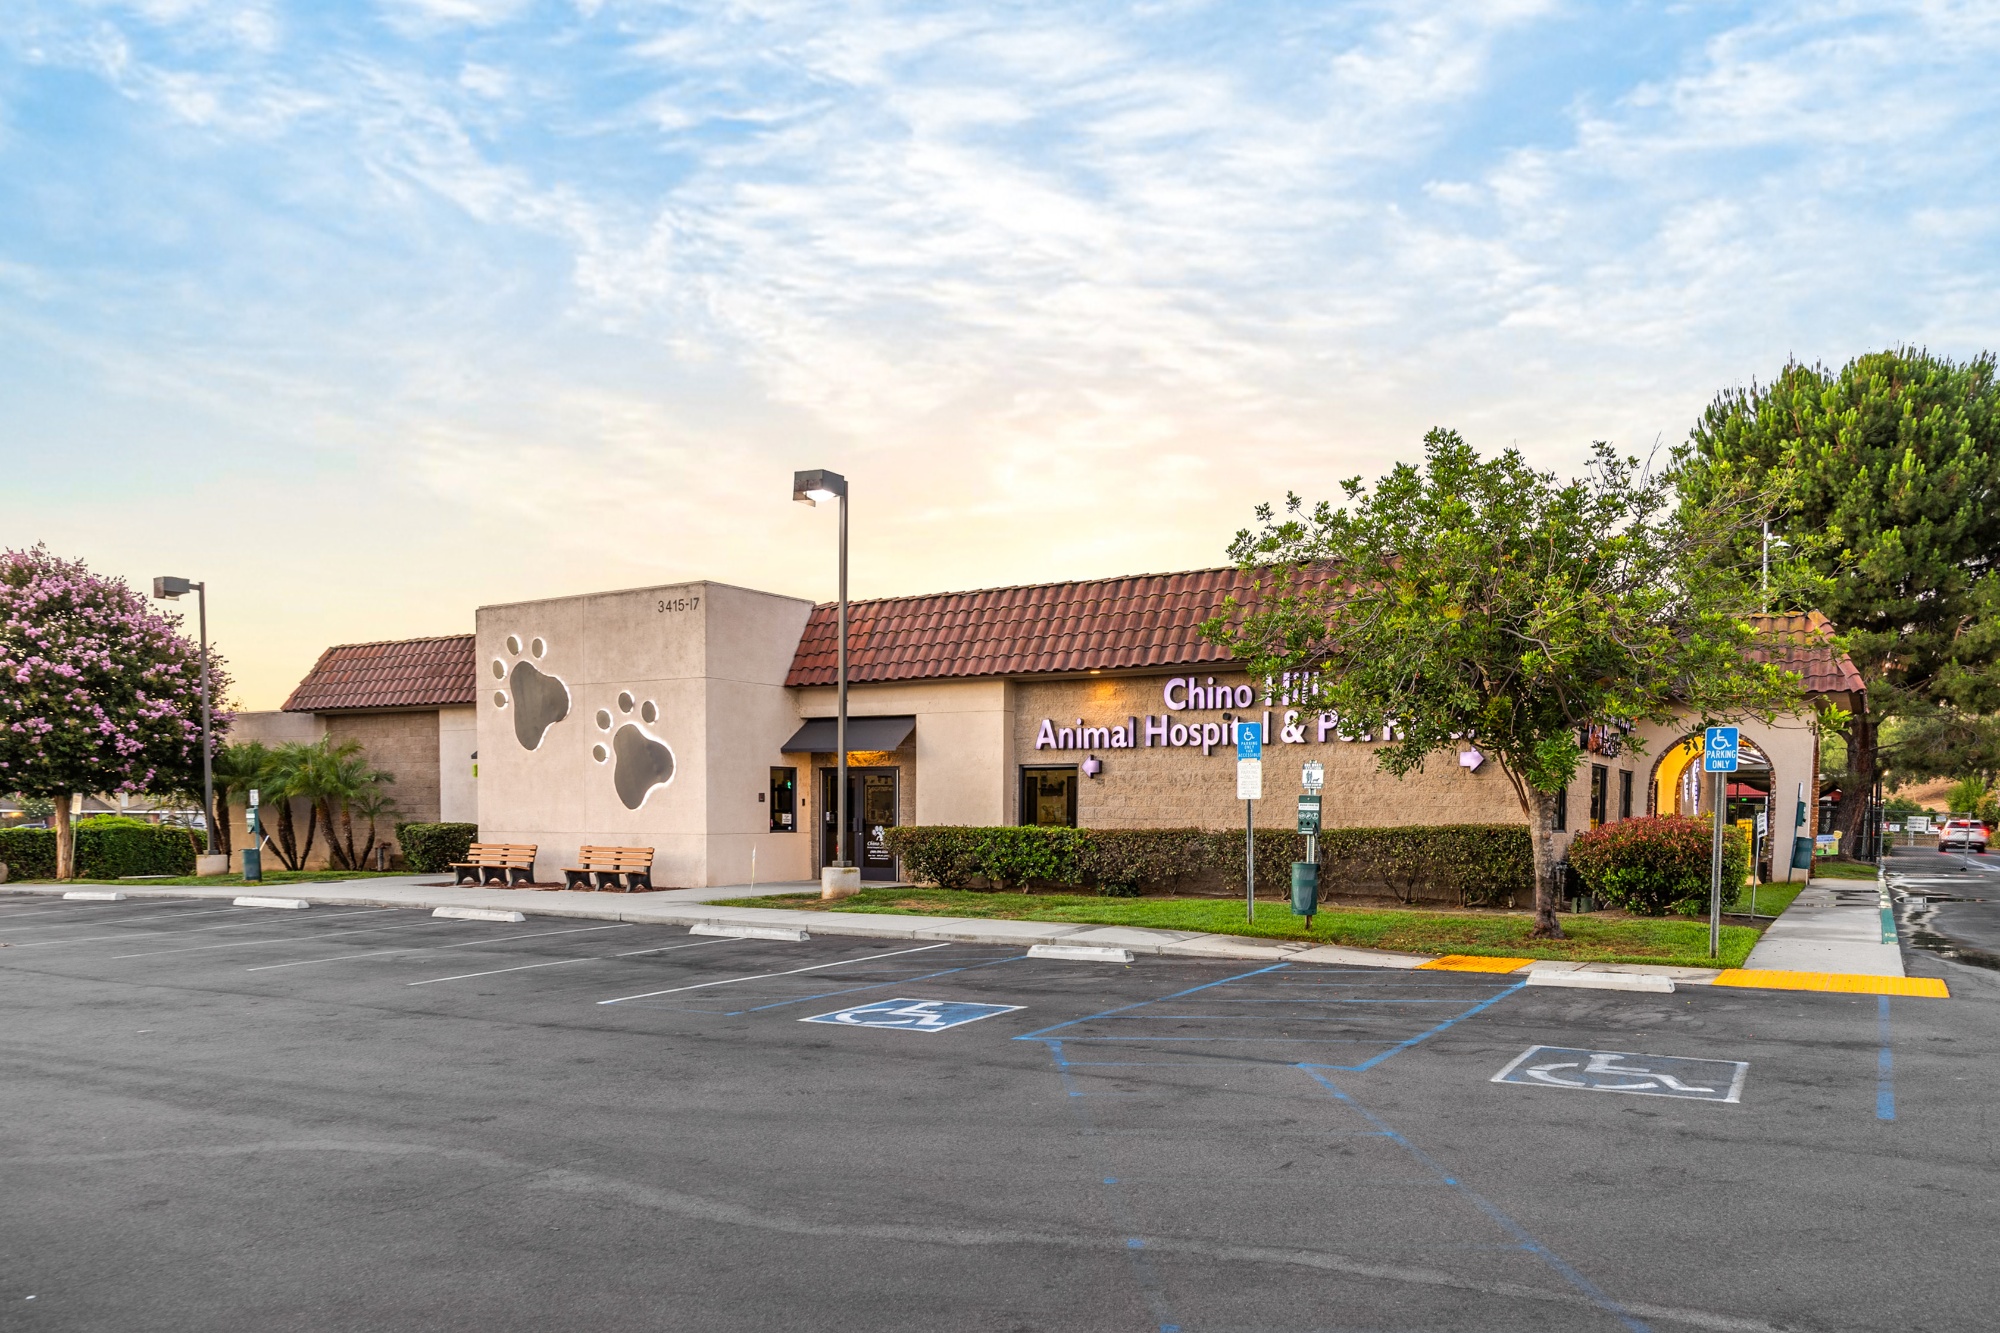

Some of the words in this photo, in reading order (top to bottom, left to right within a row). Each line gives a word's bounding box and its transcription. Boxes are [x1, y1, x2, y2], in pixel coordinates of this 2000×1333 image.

[657, 597, 700, 613] 3415-17
[1163, 676, 1253, 711] Chino
[1264, 671, 1336, 706] Hill
[1035, 716, 1136, 750] Animal
[1145, 711, 1270, 756] Hospitl
[1280, 709, 1306, 743] &
[1706, 749, 1736, 759] PARKING
[1712, 760, 1730, 769] ONLY
